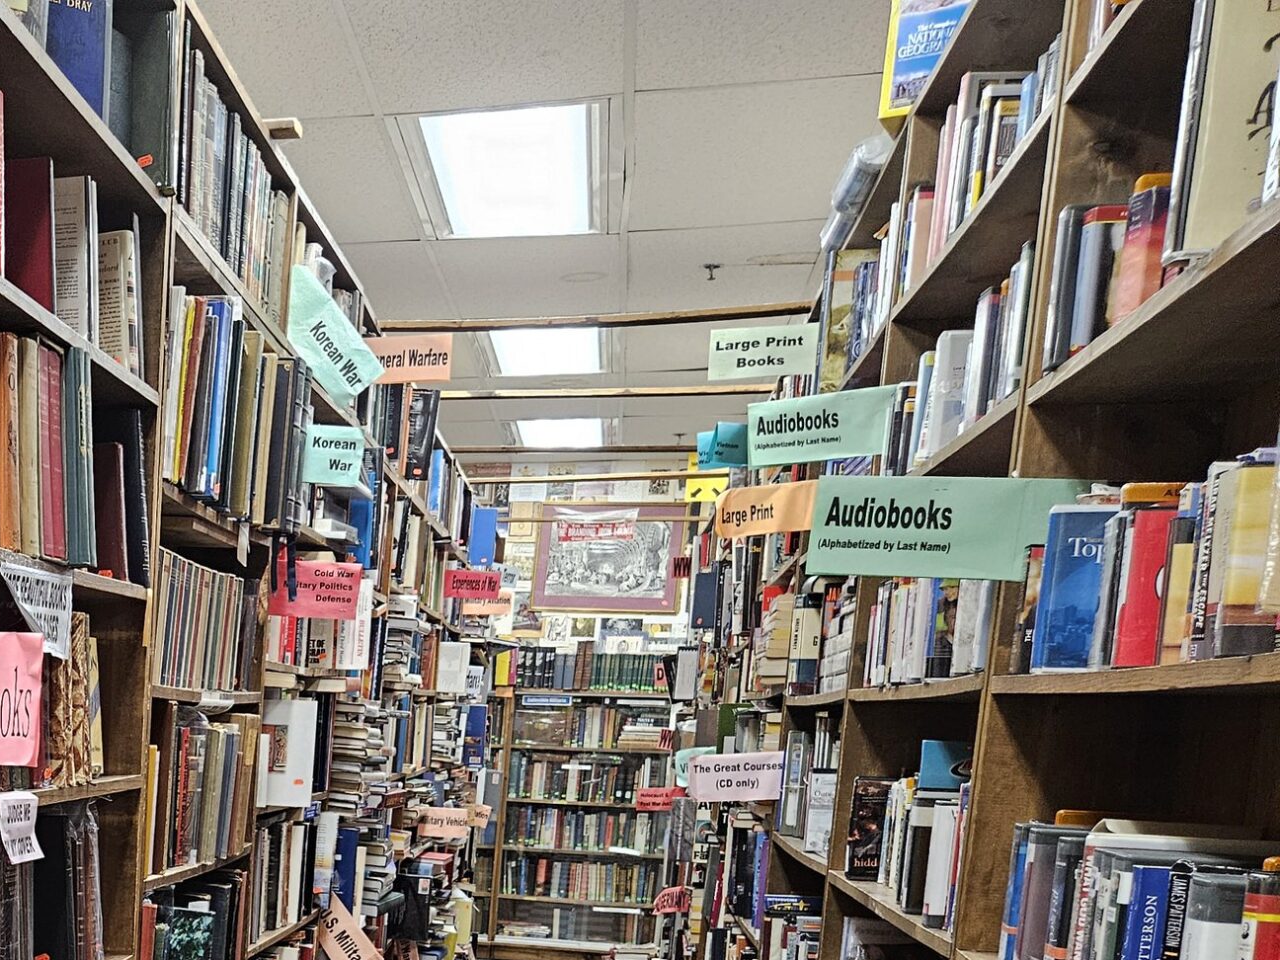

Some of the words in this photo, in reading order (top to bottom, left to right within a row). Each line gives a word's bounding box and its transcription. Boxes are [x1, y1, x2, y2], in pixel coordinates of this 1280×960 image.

[715, 339, 761, 354] Large
[765, 335, 804, 349] Print
[310, 320, 345, 366] Korean
[338, 358, 363, 389] War
[408, 348, 449, 368] Warfare
[736, 355, 785, 370] Books
[756, 408, 839, 438] Audiobooks
[312, 436, 357, 451] Korean
[754, 438, 796, 452] (Alphabetized
[820, 435, 841, 446] Name)
[328, 459, 353, 472] War
[721, 505, 747, 528] Large
[750, 503, 774, 522] Print
[824, 496, 953, 531] Audiobooks
[817, 537, 881, 554] (Alphabetized
[883, 539, 894, 553] by
[896, 541, 918, 553] Last
[919, 541, 951, 555] Name)
[314, 569, 334, 578] Cold
[337, 570, 355, 578] War
[283, 580, 317, 591] Mitary
[319, 582, 354, 591] Politics
[315, 594, 352, 604] Defense
[1195, 589, 1209, 630] ESCAPE
[693, 764, 711, 774] The
[714, 763, 741, 773] Great
[743, 761, 783, 772] Courses
[715, 778, 734, 791] (CD
[735, 777, 760, 791] only)
[1171, 874, 1186, 909] JAMES
[1166, 906, 1184, 948] PATTERSON
